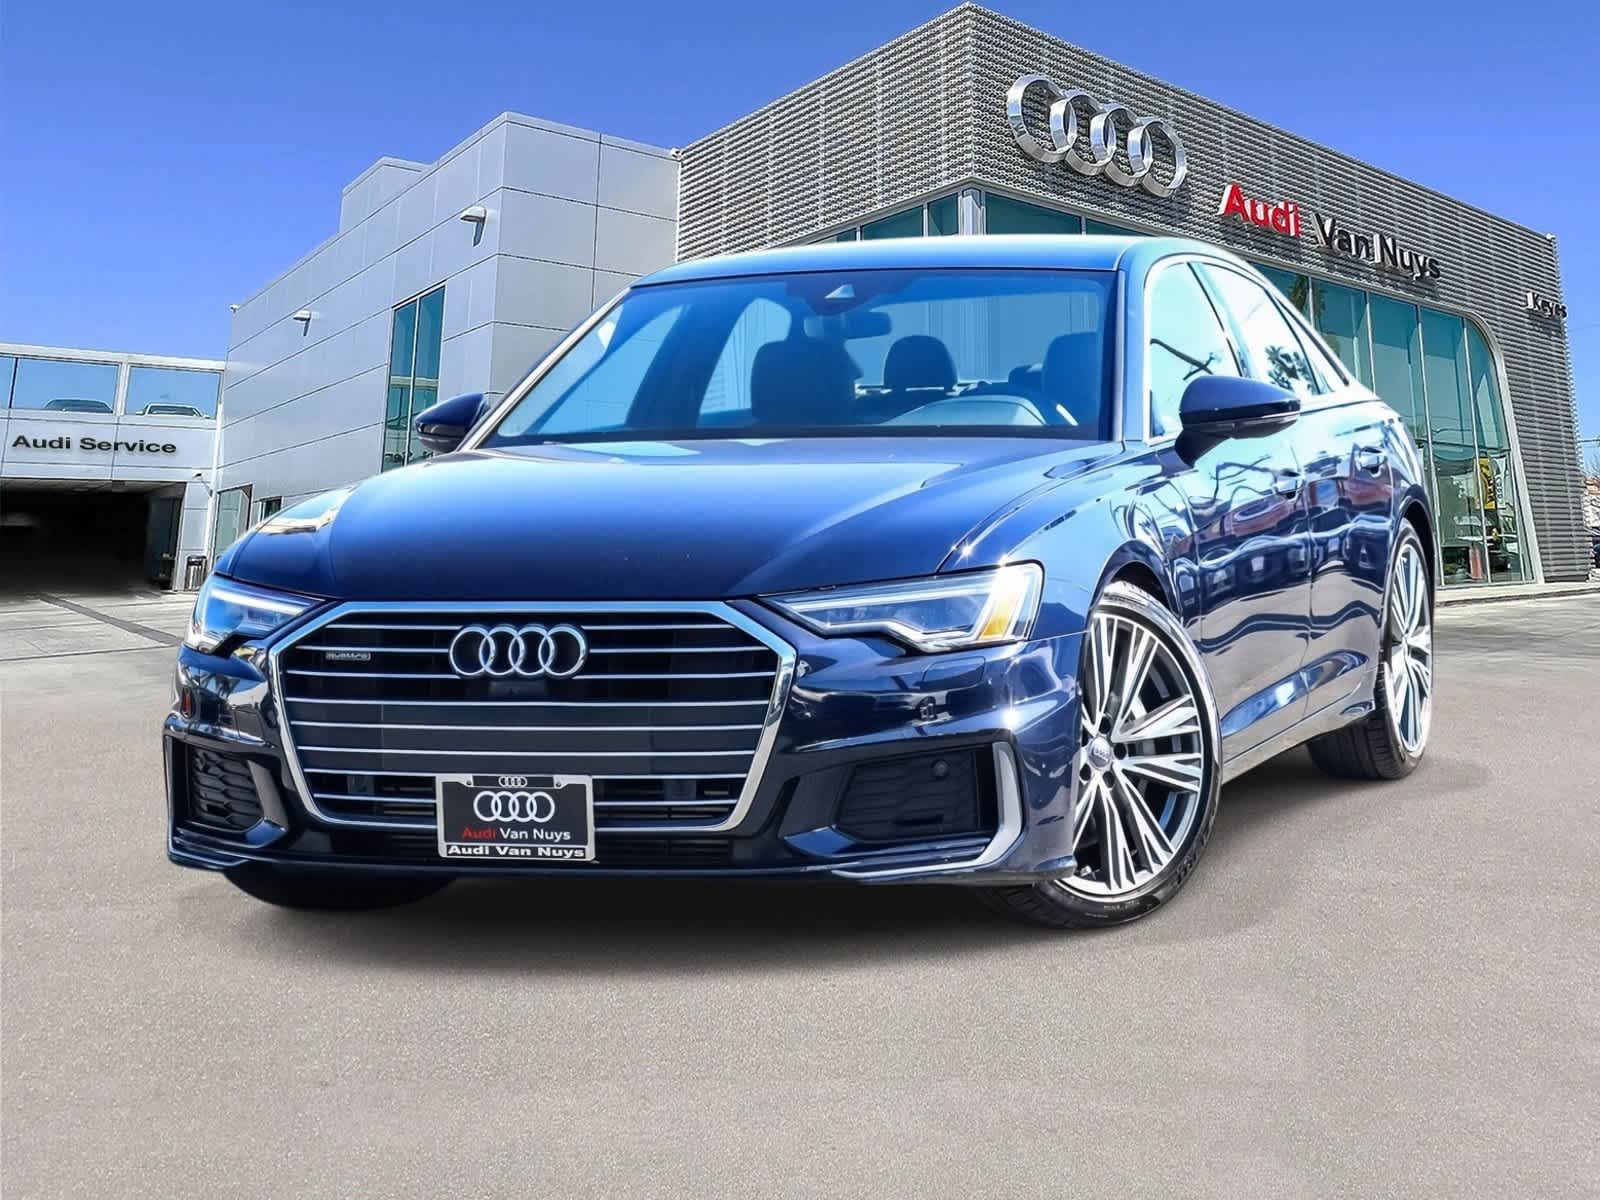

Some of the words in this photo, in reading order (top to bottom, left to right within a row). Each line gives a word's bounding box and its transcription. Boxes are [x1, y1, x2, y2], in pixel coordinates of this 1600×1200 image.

[1219, 182, 1302, 238] Audi
[1311, 213, 1371, 258] Van
[1373, 233, 1441, 280] Nuys
[12, 435, 71, 449] Audi
[80, 437, 177, 454] Service
[462, 827, 496, 839] Audi
[500, 828, 528, 840] Van
[533, 828, 571, 842] Nuys
[448, 845, 490, 855] Audi
[496, 846, 531, 856] Van
[538, 847, 585, 859] Nuys
